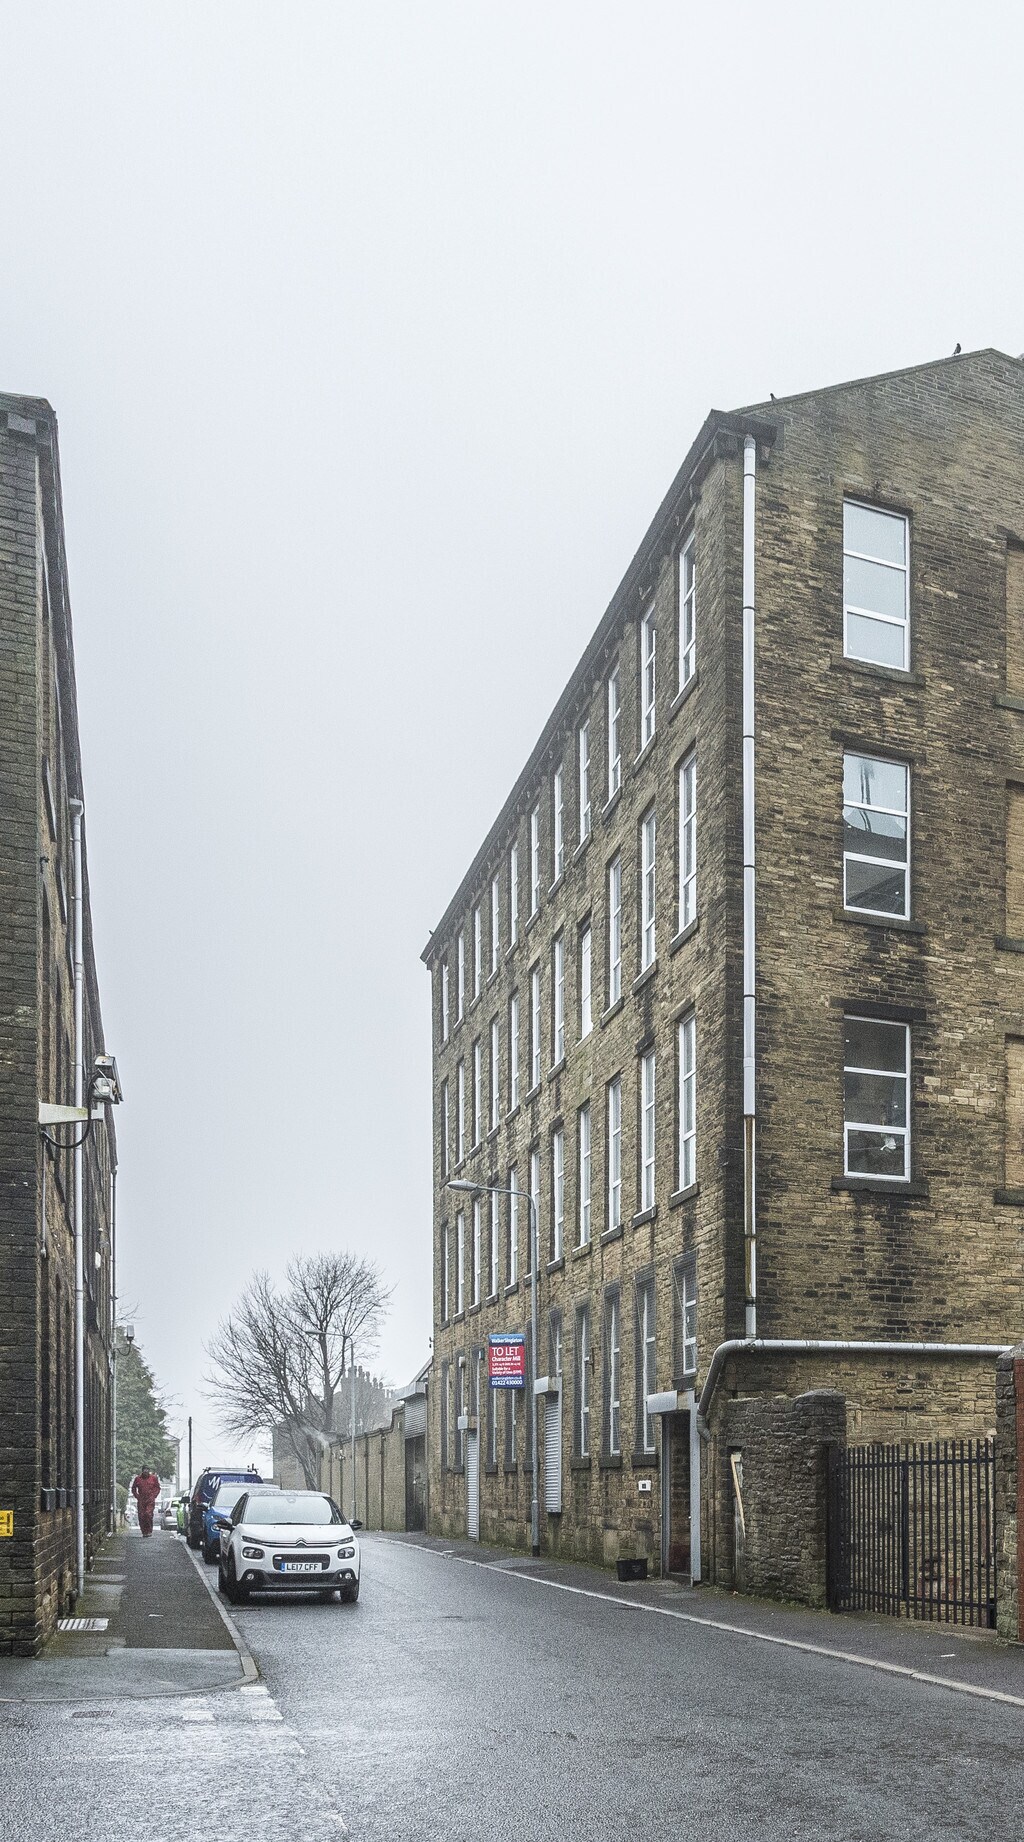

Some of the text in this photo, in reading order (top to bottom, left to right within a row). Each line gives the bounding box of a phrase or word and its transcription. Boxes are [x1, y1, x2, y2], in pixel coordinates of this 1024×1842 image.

[492, 1347, 519, 1356] TO LET
[286, 1563, 319, 1571] LE17 CFF
